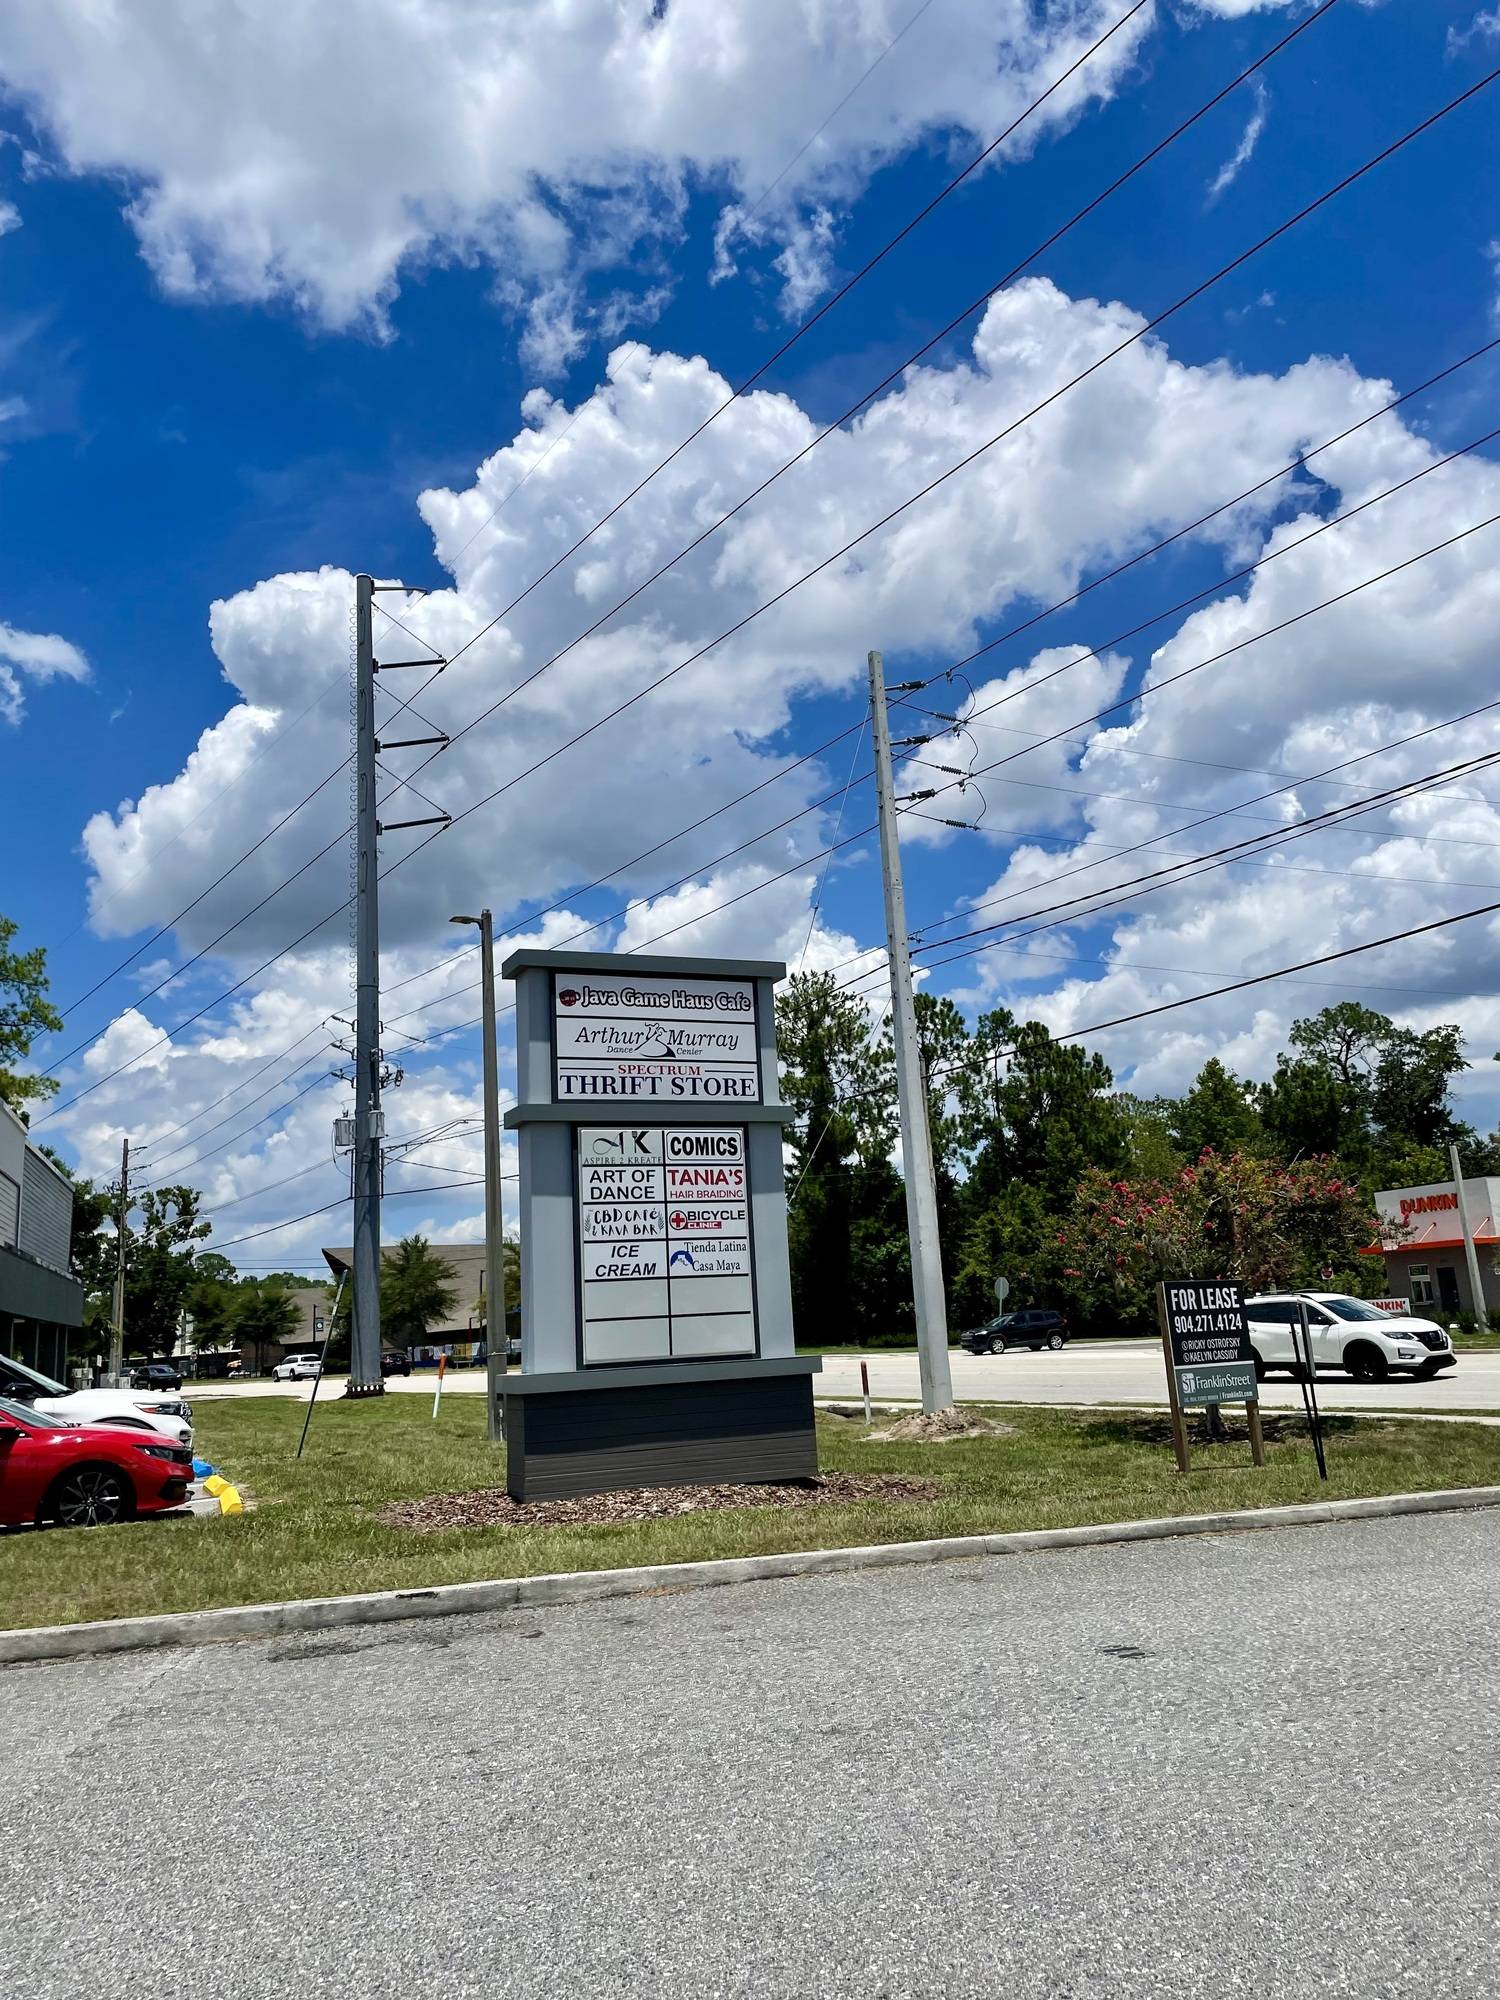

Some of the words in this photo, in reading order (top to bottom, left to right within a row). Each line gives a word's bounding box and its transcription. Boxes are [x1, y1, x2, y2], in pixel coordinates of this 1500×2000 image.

[582, 986, 619, 1007] Java
[620, 988, 670, 1008] Game
[672, 990, 714, 1010] Haus
[715, 992, 751, 1011] Cafe
[575, 1026, 644, 1044] Arthur
[667, 1029, 739, 1050] Murray
[606, 1045, 634, 1054] Dance
[676, 1047, 703, 1056] Center
[618, 1064, 701, 1076] SPECTRUM
[560, 1075, 662, 1095] THRIFT
[671, 1077, 755, 1097] STORE
[670, 1136, 738, 1156] COMICS
[583, 1156, 616, 1165] ASPIRE
[619, 1156, 625, 1165] 2
[627, 1156, 663, 1164] KREATE
[589, 1169, 627, 1183] ART
[631, 1169, 656, 1183] OF
[667, 1168, 743, 1186] TANIA'S
[590, 1185, 656, 1200] DANCE
[670, 1190, 695, 1199] HAIR
[696, 1189, 744, 1199] BRAIDING
[594, 1208, 623, 1224] CBD
[687, 1210, 746, 1221] BICYCLE
[601, 1224, 629, 1236] KAVA
[633, 1223, 658, 1236] BAR
[687, 1221, 720, 1229] CLINIC
[611, 1245, 640, 1258] ICE
[684, 1241, 716, 1253] Tienda
[719, 1241, 747, 1252] Latina
[595, 1262, 657, 1277] CREAM
[692, 1260, 714, 1271] Casa
[716, 1259, 741, 1273] Maya
[1170, 1288, 1198, 1311] FOR
[1199, 1287, 1240, 1310] LEASE
[1174, 1313, 1243, 1334] 904.271.4124
[1188, 1339, 1206, 1350] RICKY
[1207, 1337, 1241, 1349] OSTROFSKY
[1190, 1351, 1213, 1362] KAELYN
[1213, 1349, 1238, 1361] CASSIDY
